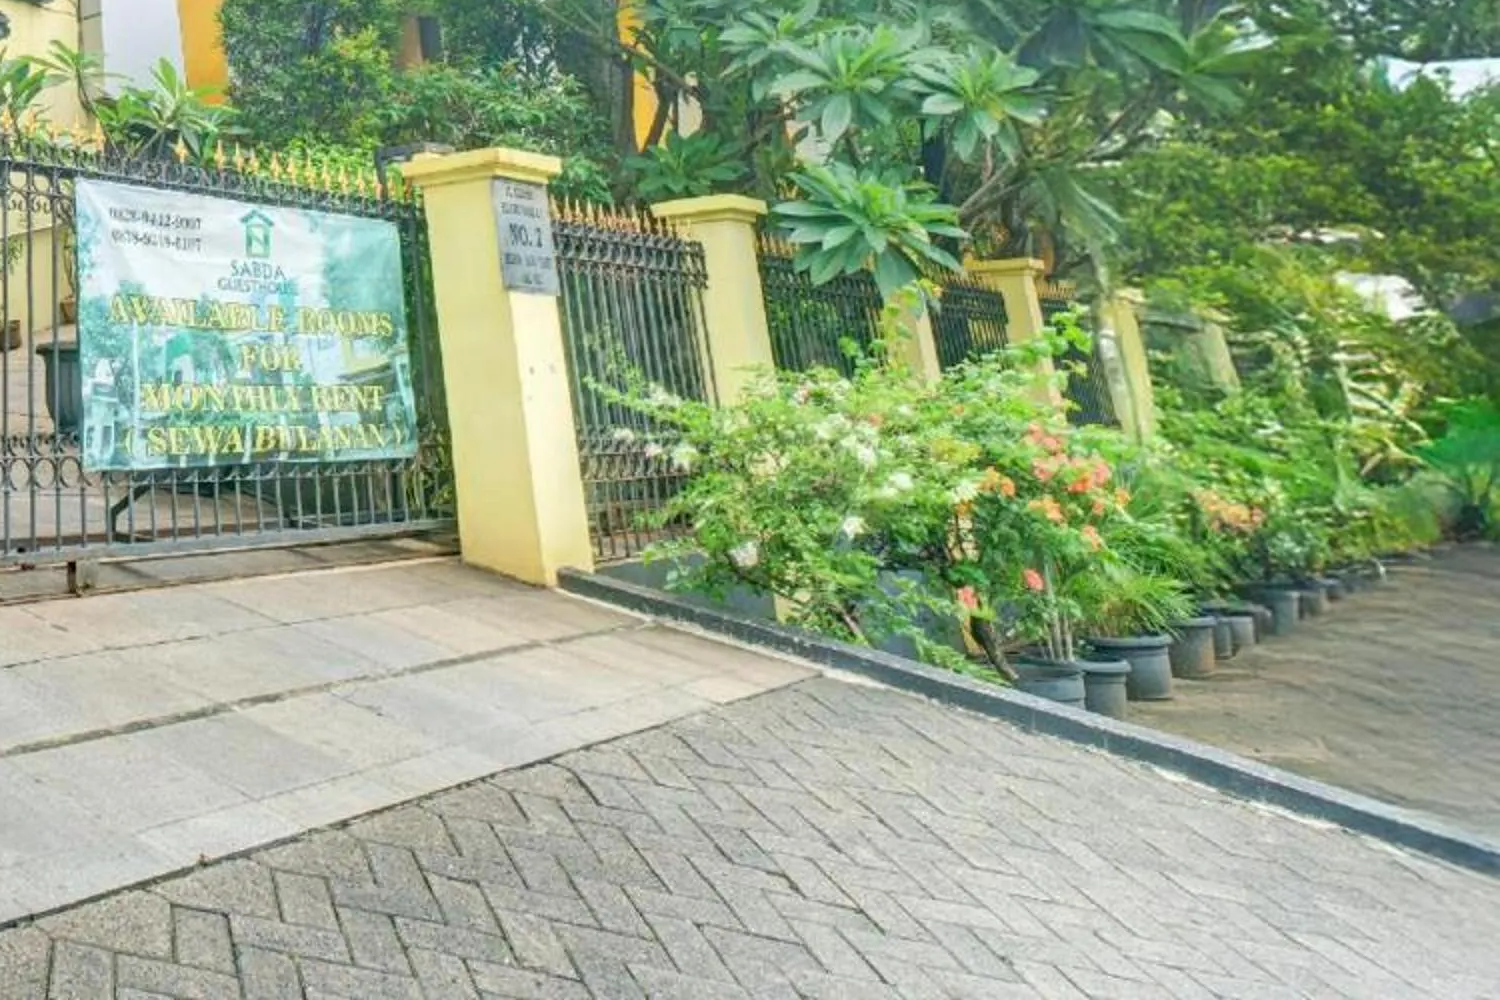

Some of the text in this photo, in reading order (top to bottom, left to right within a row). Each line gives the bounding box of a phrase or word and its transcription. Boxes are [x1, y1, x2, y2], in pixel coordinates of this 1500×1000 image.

[230, 260, 286, 280] SABDA
[109, 294, 393, 337] AVAILABLE ROOMS
[239, 344, 301, 372] FOR
[141, 384, 384, 411] MONTHLY RENT
[148, 425, 245, 454] SEWA
[255, 424, 387, 454] BULANAN
